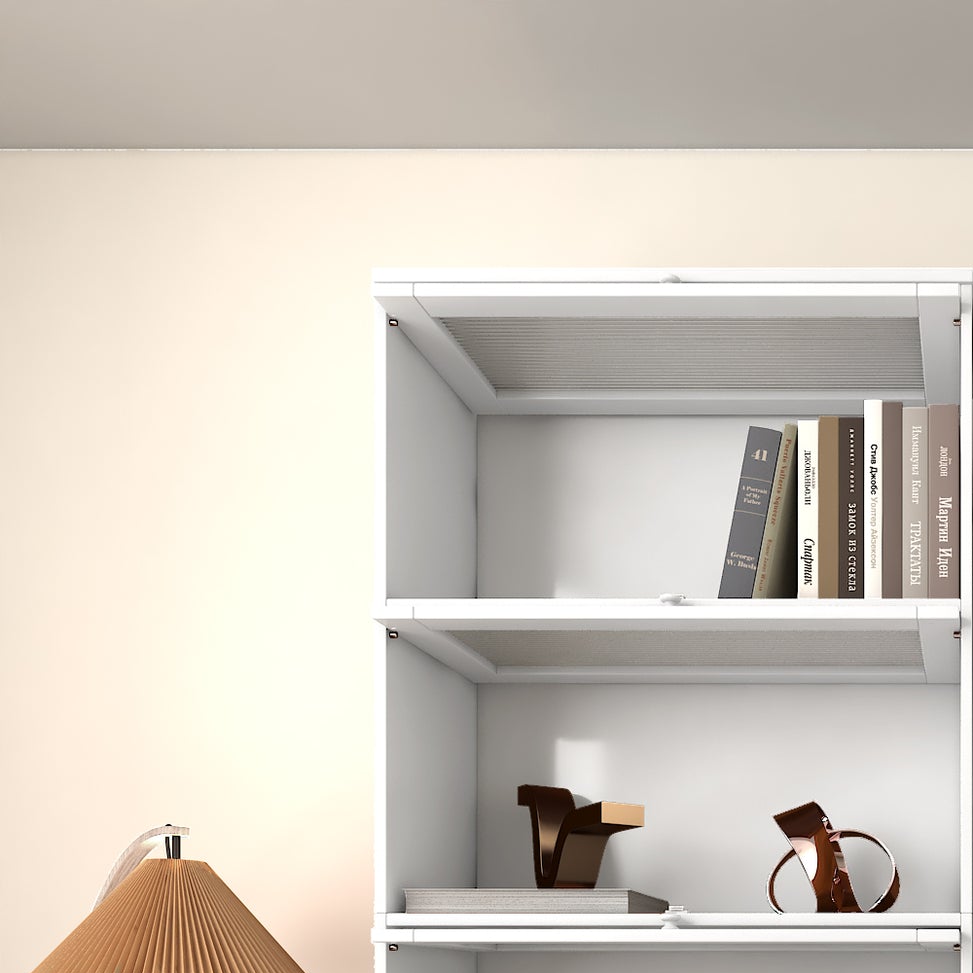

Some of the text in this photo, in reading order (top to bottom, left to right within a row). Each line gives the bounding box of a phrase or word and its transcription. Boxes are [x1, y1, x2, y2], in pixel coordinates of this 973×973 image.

[751, 449, 767, 462] 41
[910, 426, 922, 505] Иммануил Кант
[743, 497, 761, 505] Father
[869, 443, 878, 569] Стив Джобс Уолтер Айзексон
[730, 550, 755, 562] George
[910, 521, 922, 586] ТРАКТАТЫ
[936, 497, 952, 578] Мартин Иден
[737, 560, 757, 570] Bush
[800, 538, 815, 585] Спартак
